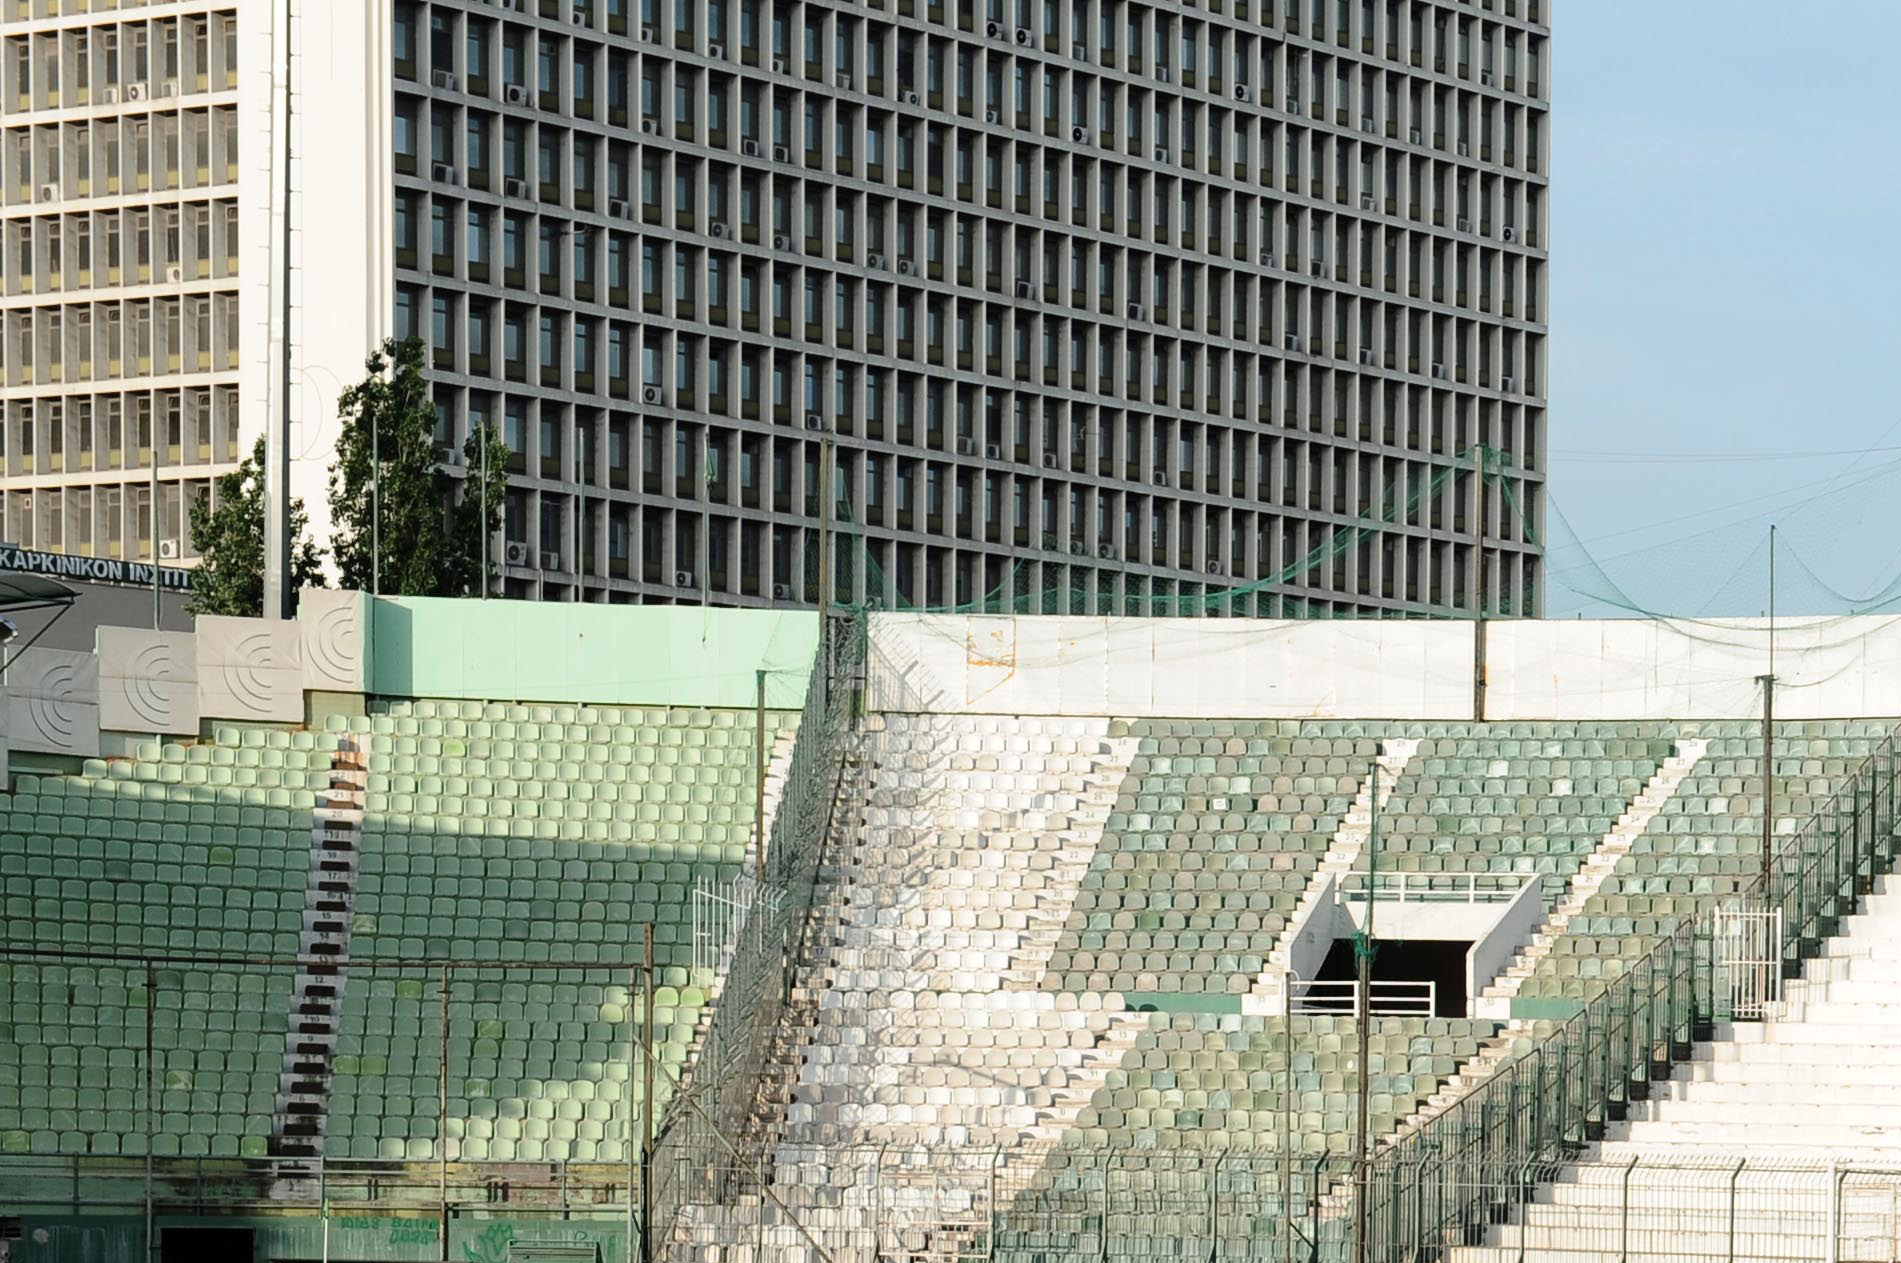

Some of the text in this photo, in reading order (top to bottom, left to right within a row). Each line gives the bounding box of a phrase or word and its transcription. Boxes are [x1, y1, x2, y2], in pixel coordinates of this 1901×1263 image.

[331, 809, 343, 818] 20
[327, 871, 338, 880] 17
[314, 975, 325, 984] 12
